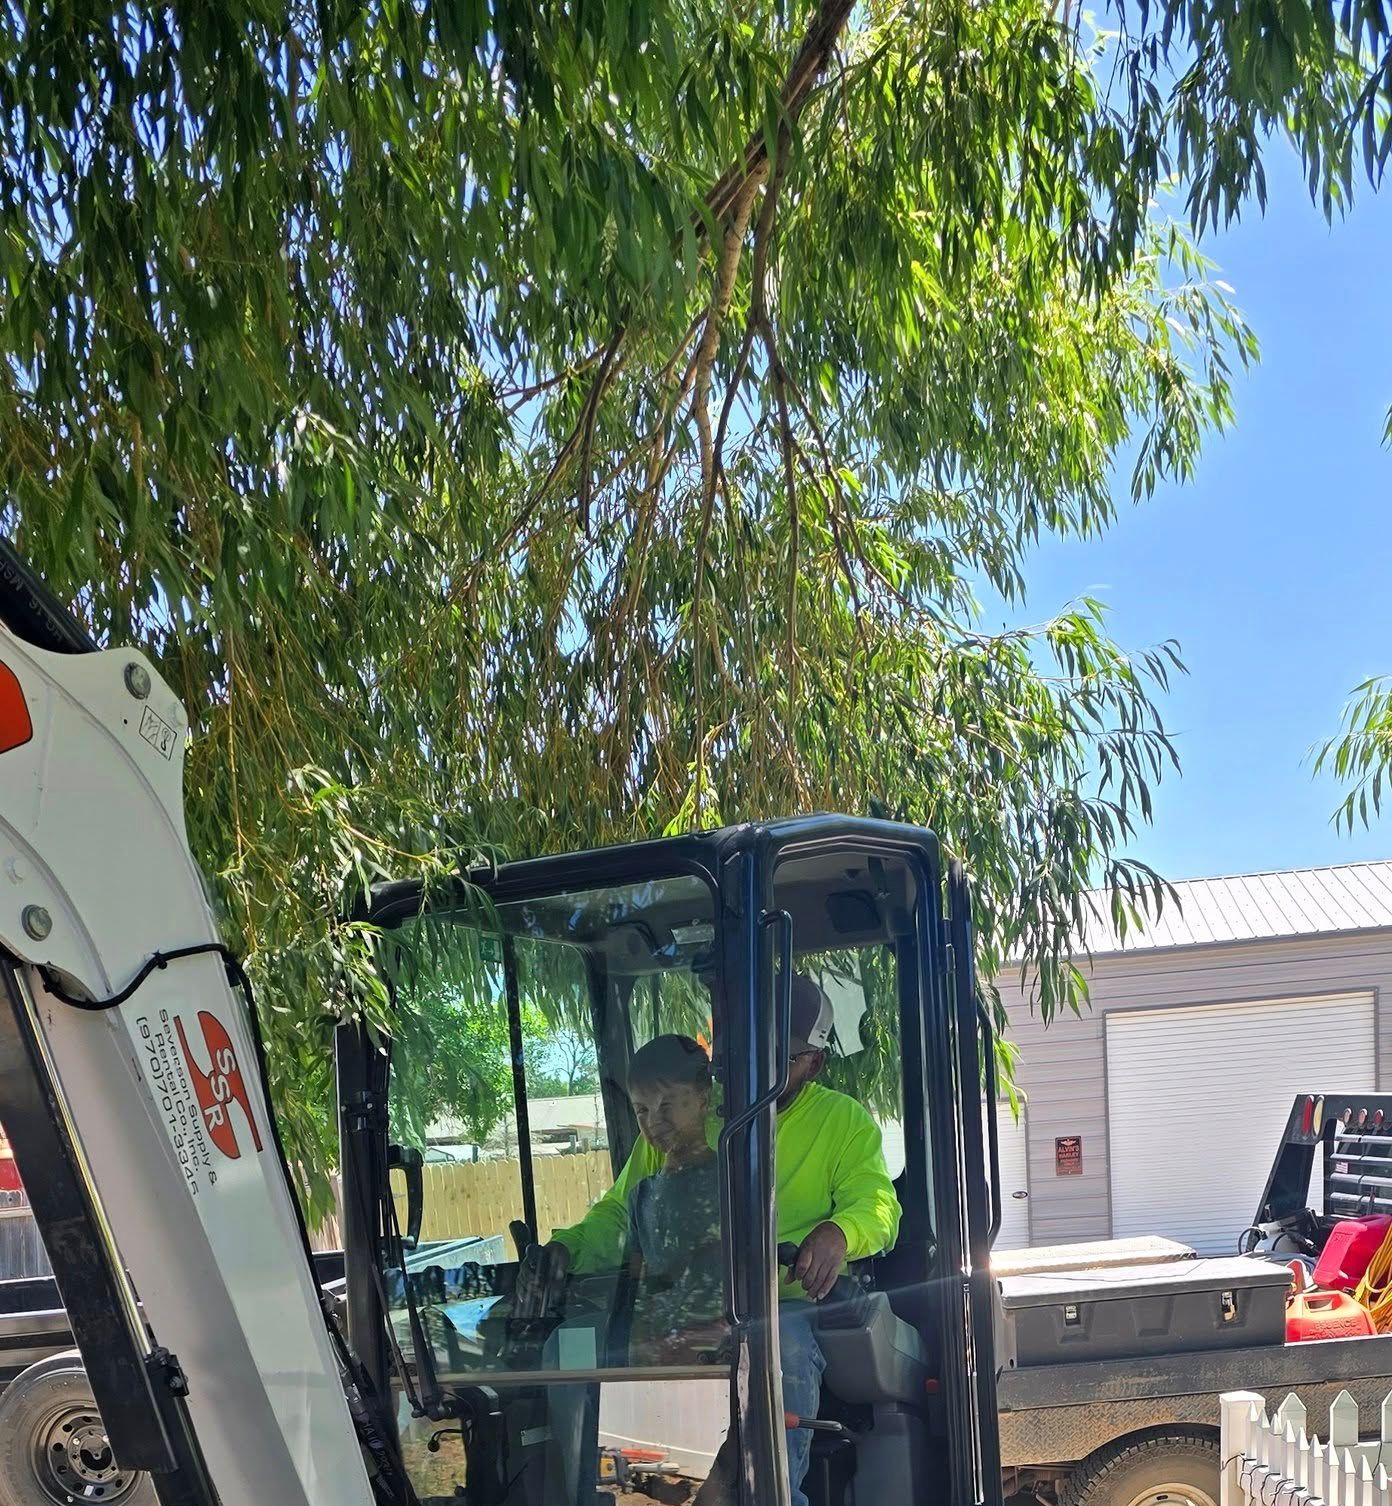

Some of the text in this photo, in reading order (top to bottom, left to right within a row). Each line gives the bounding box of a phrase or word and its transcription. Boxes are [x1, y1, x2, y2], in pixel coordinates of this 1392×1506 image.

[155, 1033, 200, 1172] Rental Co., Inc.
[159, 1008, 218, 1186] Severson Supply &
[204, 1048, 236, 1132] SSR
